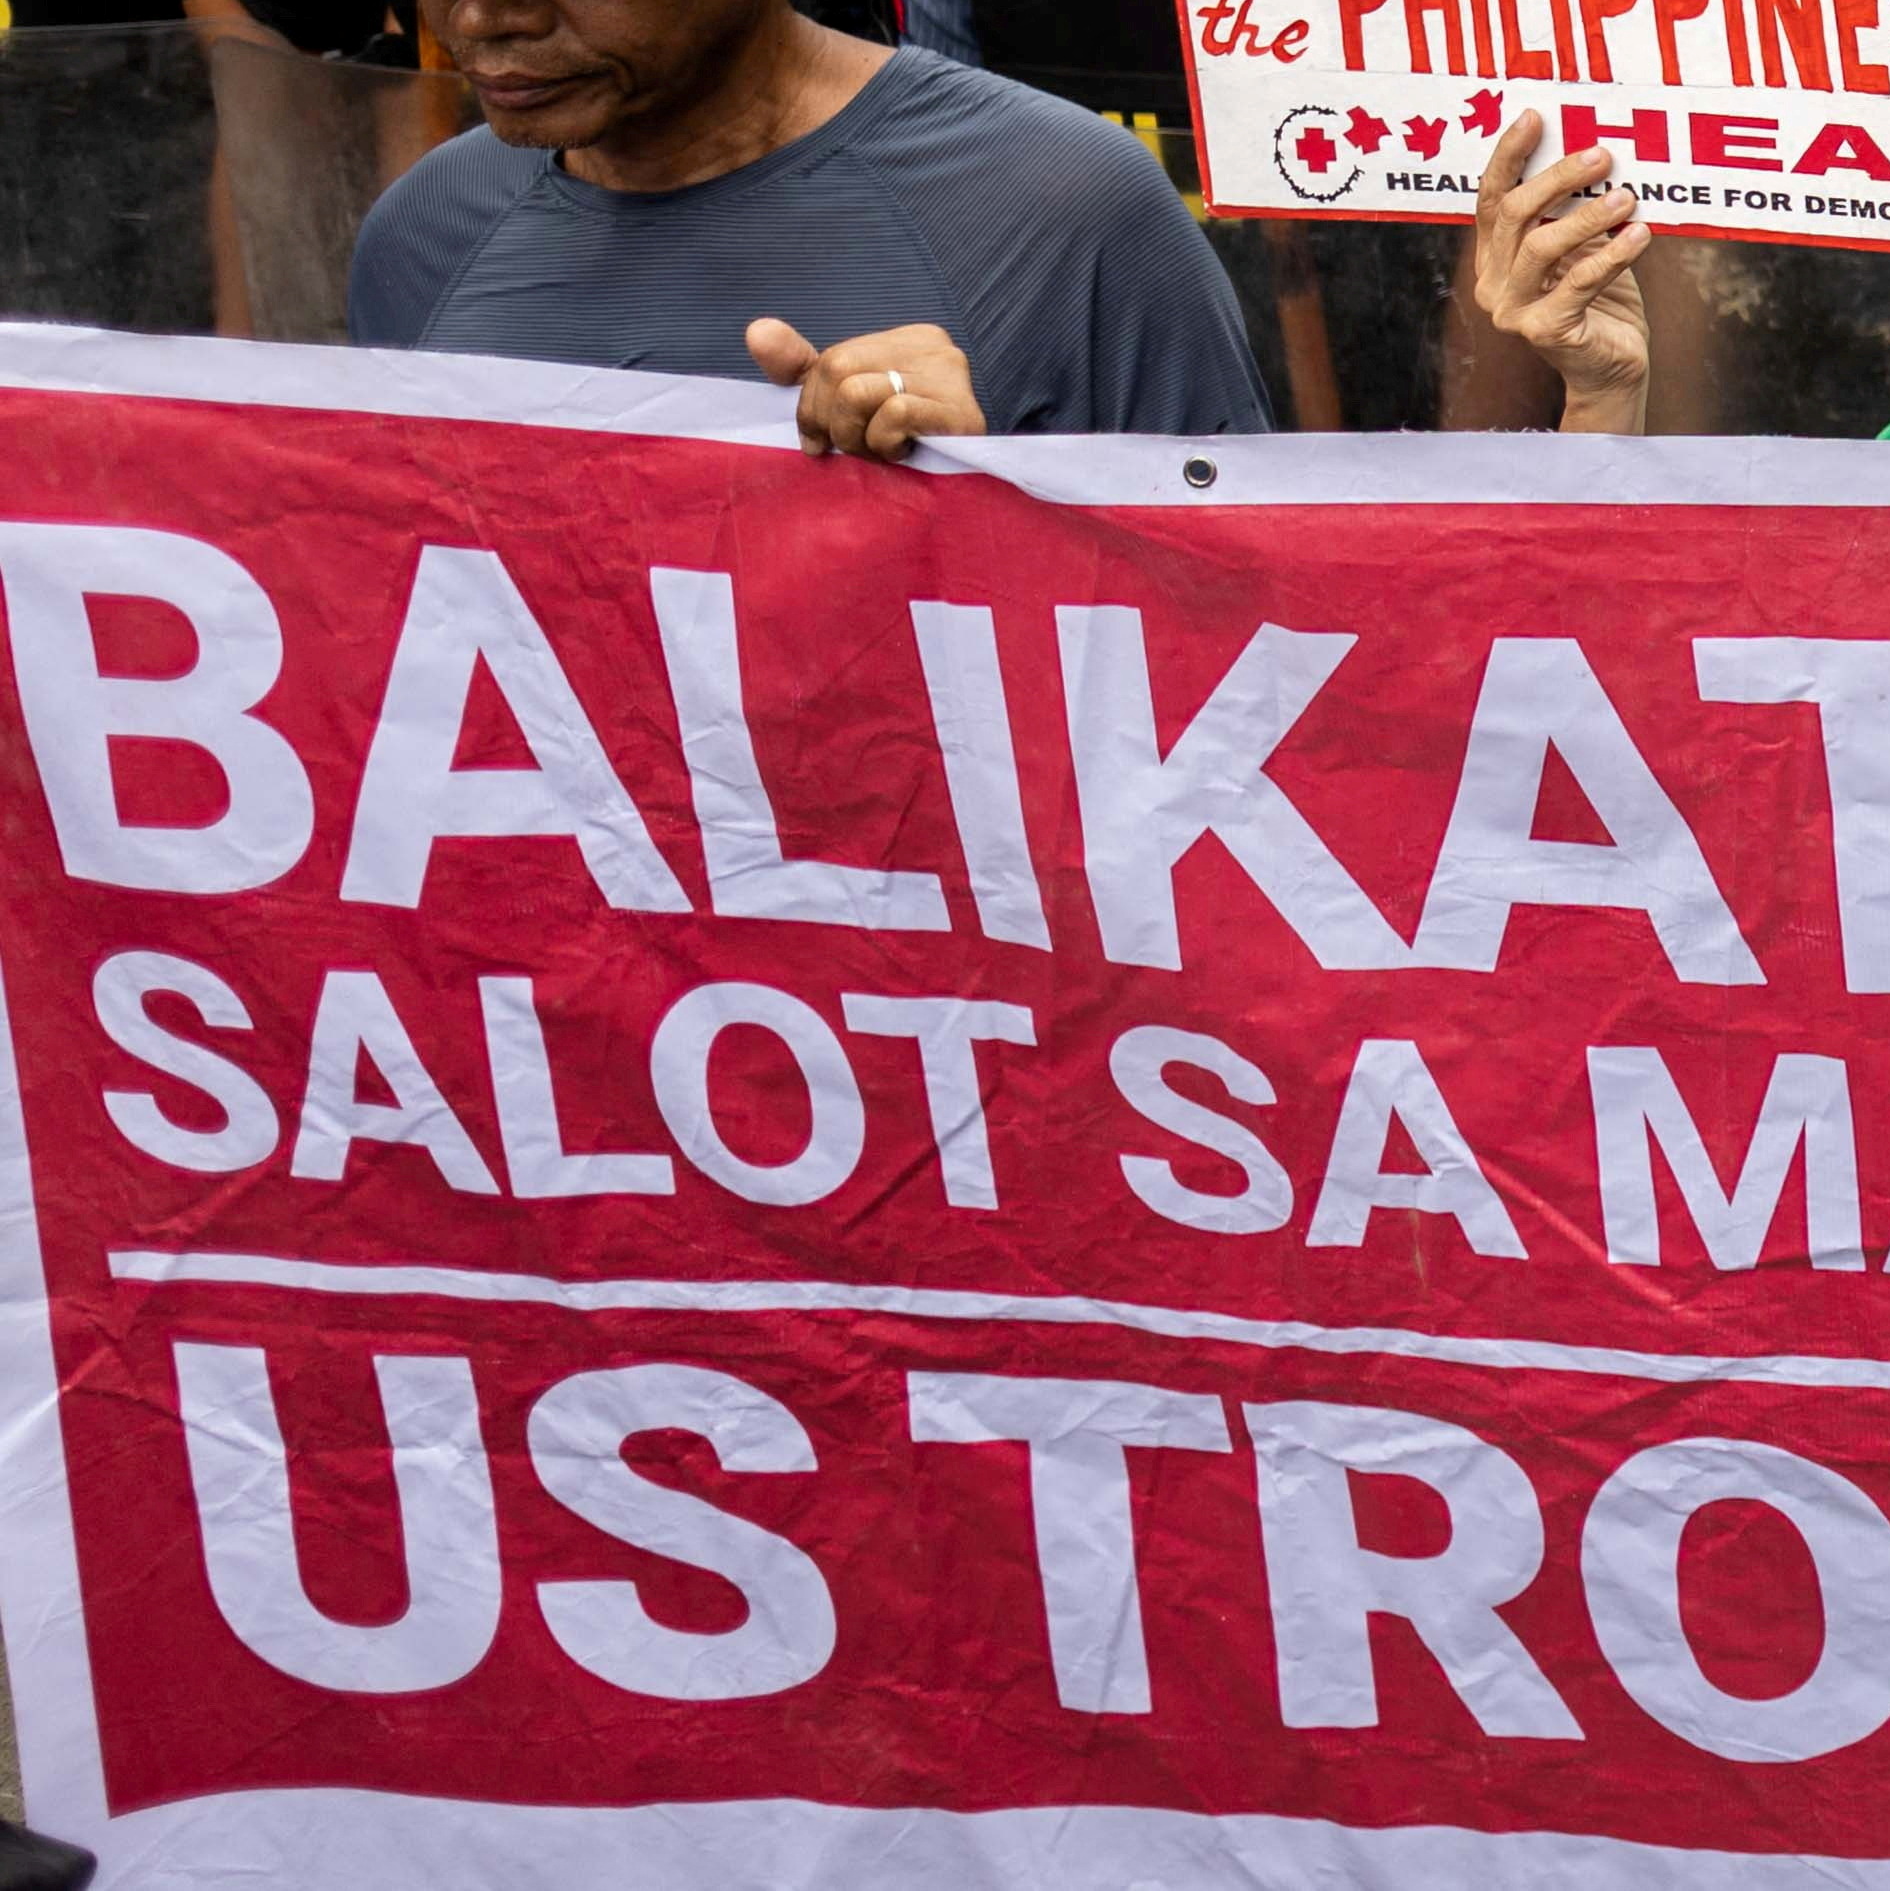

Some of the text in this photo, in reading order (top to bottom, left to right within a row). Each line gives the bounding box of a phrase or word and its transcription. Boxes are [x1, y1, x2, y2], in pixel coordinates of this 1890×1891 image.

[1386, 170, 1481, 195] HEAL
[1724, 187, 1793, 212] FOR
[93, 951, 1037, 1209] SALOT
[1110, 1026, 1528, 1259] SA
[174, 1342, 836, 1700] US
